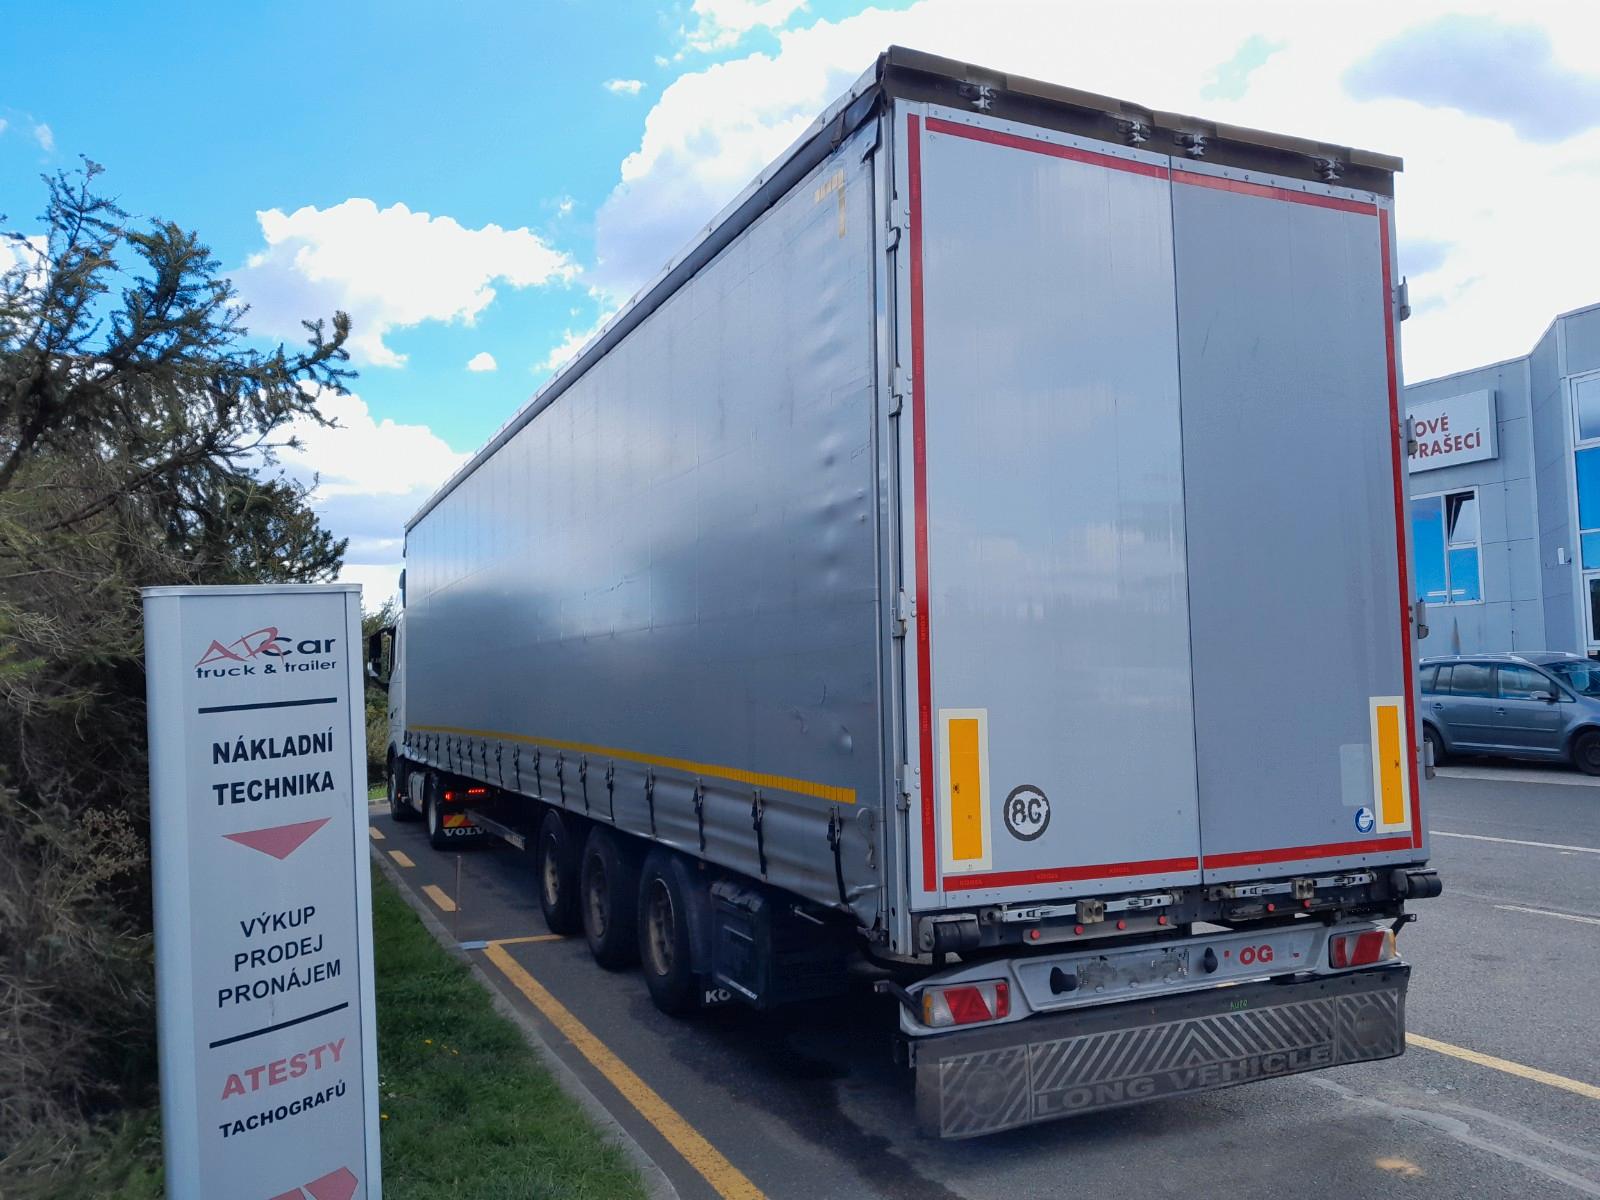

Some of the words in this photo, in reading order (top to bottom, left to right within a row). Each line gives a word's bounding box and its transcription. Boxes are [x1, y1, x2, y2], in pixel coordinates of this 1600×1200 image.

[1412, 428, 1480, 459] RAŠECÍ
[195, 665, 255, 679] truck
[263, 664, 277, 674] &
[285, 660, 336, 673] trailer
[212, 727, 333, 764] NÁKLADNÍ
[212, 771, 334, 806] TECHNIKA
[240, 905, 316, 938] VÝKUP
[234, 934, 323, 972] PRODEJ
[218, 959, 341, 1008] PRONÁJEM
[221, 1038, 345, 1100] ATESTY
[1038, 1078, 1155, 1113] LONG
[1168, 1047, 1332, 1089] VEHICLE
